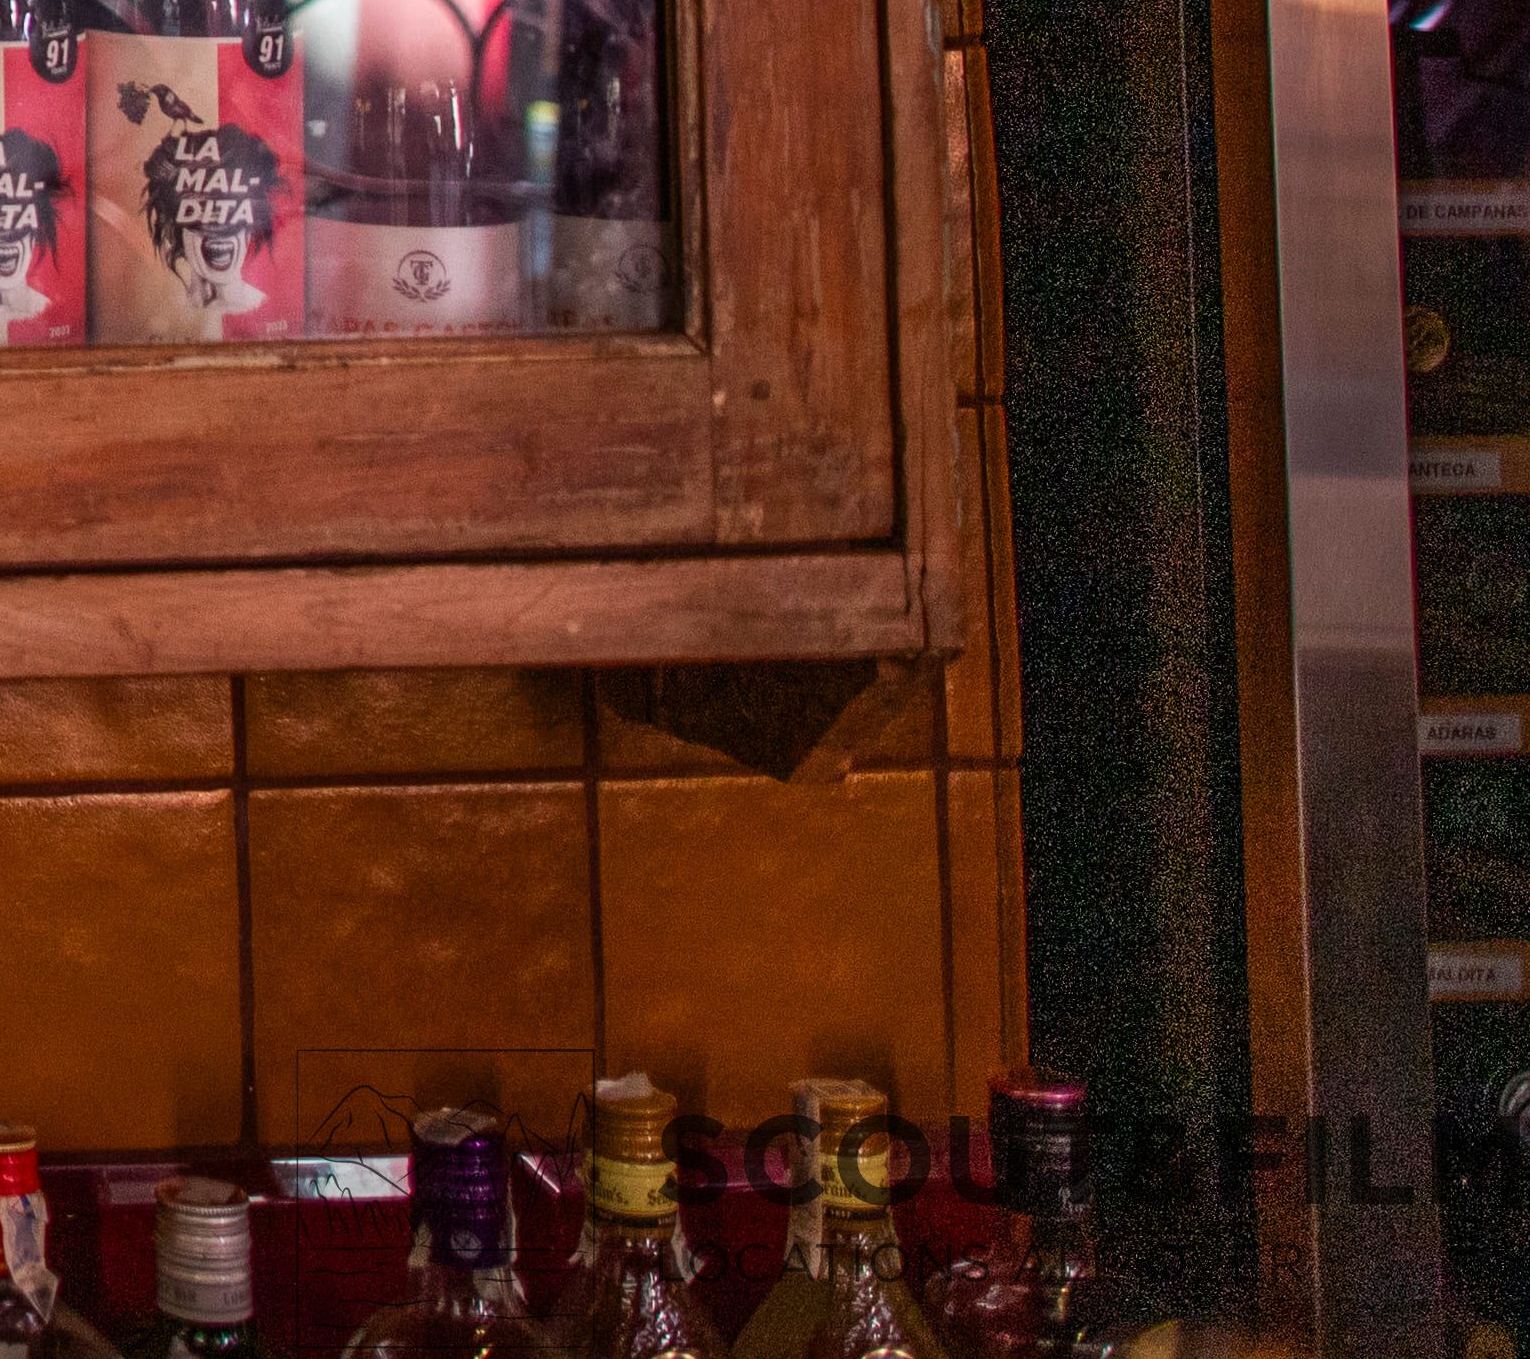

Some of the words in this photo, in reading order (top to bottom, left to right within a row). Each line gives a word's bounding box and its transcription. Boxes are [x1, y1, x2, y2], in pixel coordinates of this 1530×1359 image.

[45, 39, 70, 69] 91
[259, 34, 284, 64] 91
[175, 135, 221, 162] LA
[176, 167, 261, 194] MAL-
[176, 198, 255, 225] DITA
